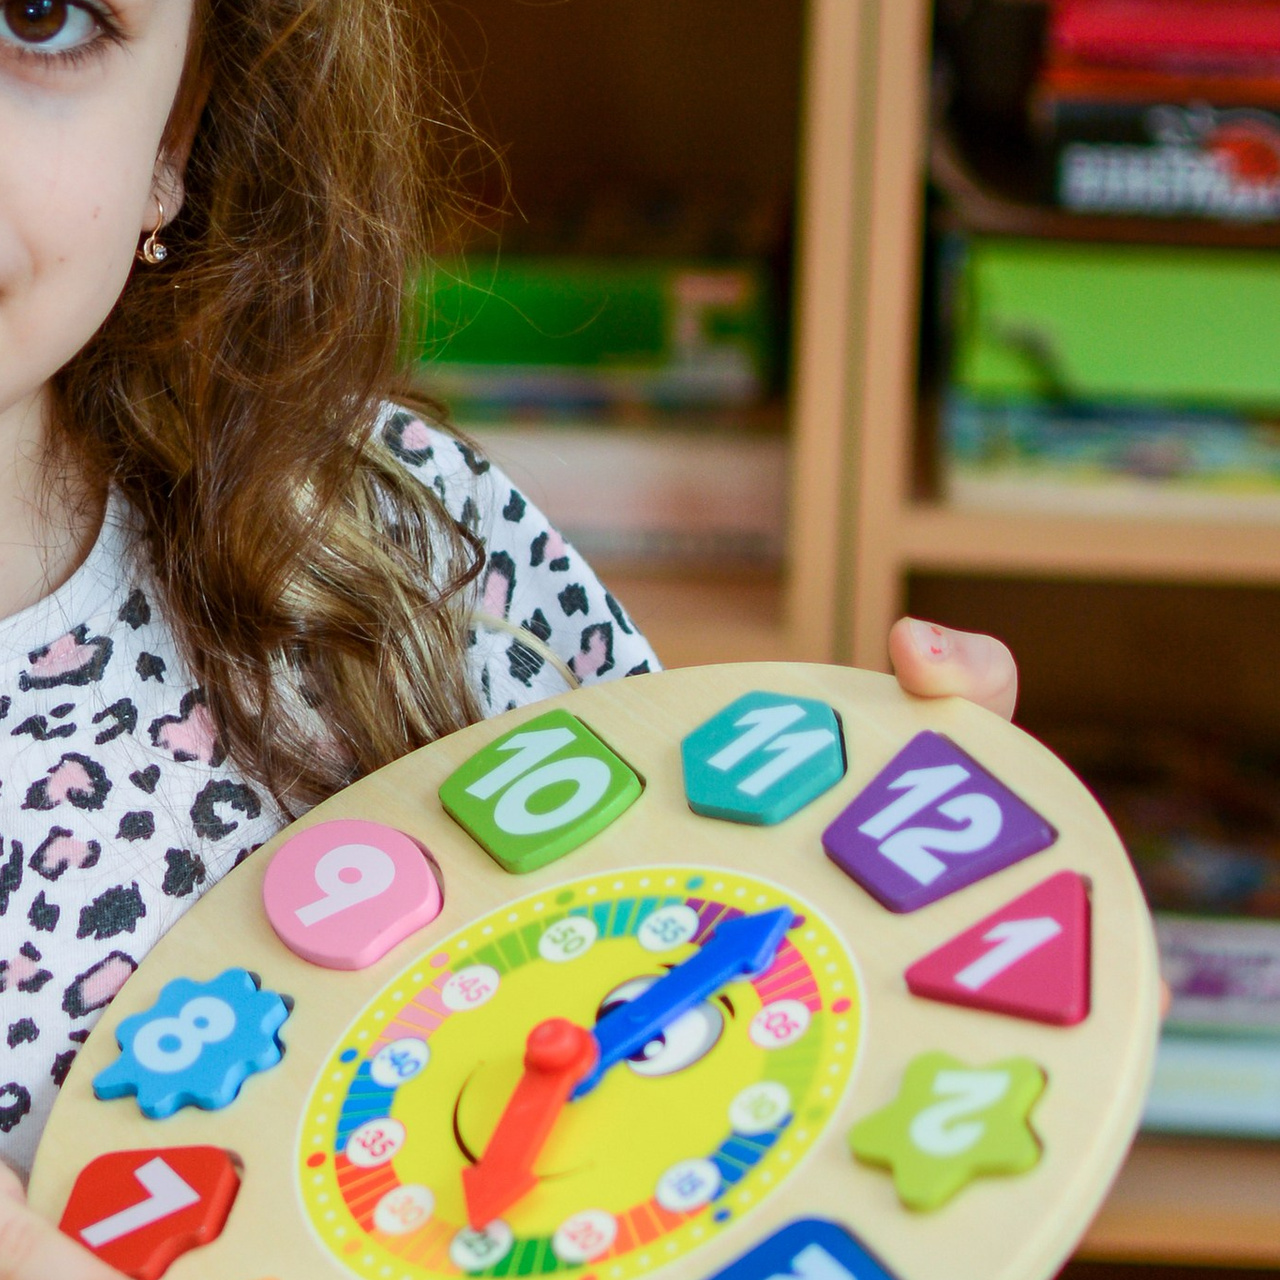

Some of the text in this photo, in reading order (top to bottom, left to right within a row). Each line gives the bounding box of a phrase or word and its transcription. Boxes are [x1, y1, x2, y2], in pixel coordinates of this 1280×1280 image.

[465, 727, 612, 836] 10
[708, 703, 833, 796] 11
[858, 764, 1003, 886] 12
[295, 843, 395, 927] 9
[955, 917, 1062, 990] 1
[133, 996, 236, 1073] 8
[909, 1072, 1011, 1158] 2
[80, 1157, 200, 1247] 7
